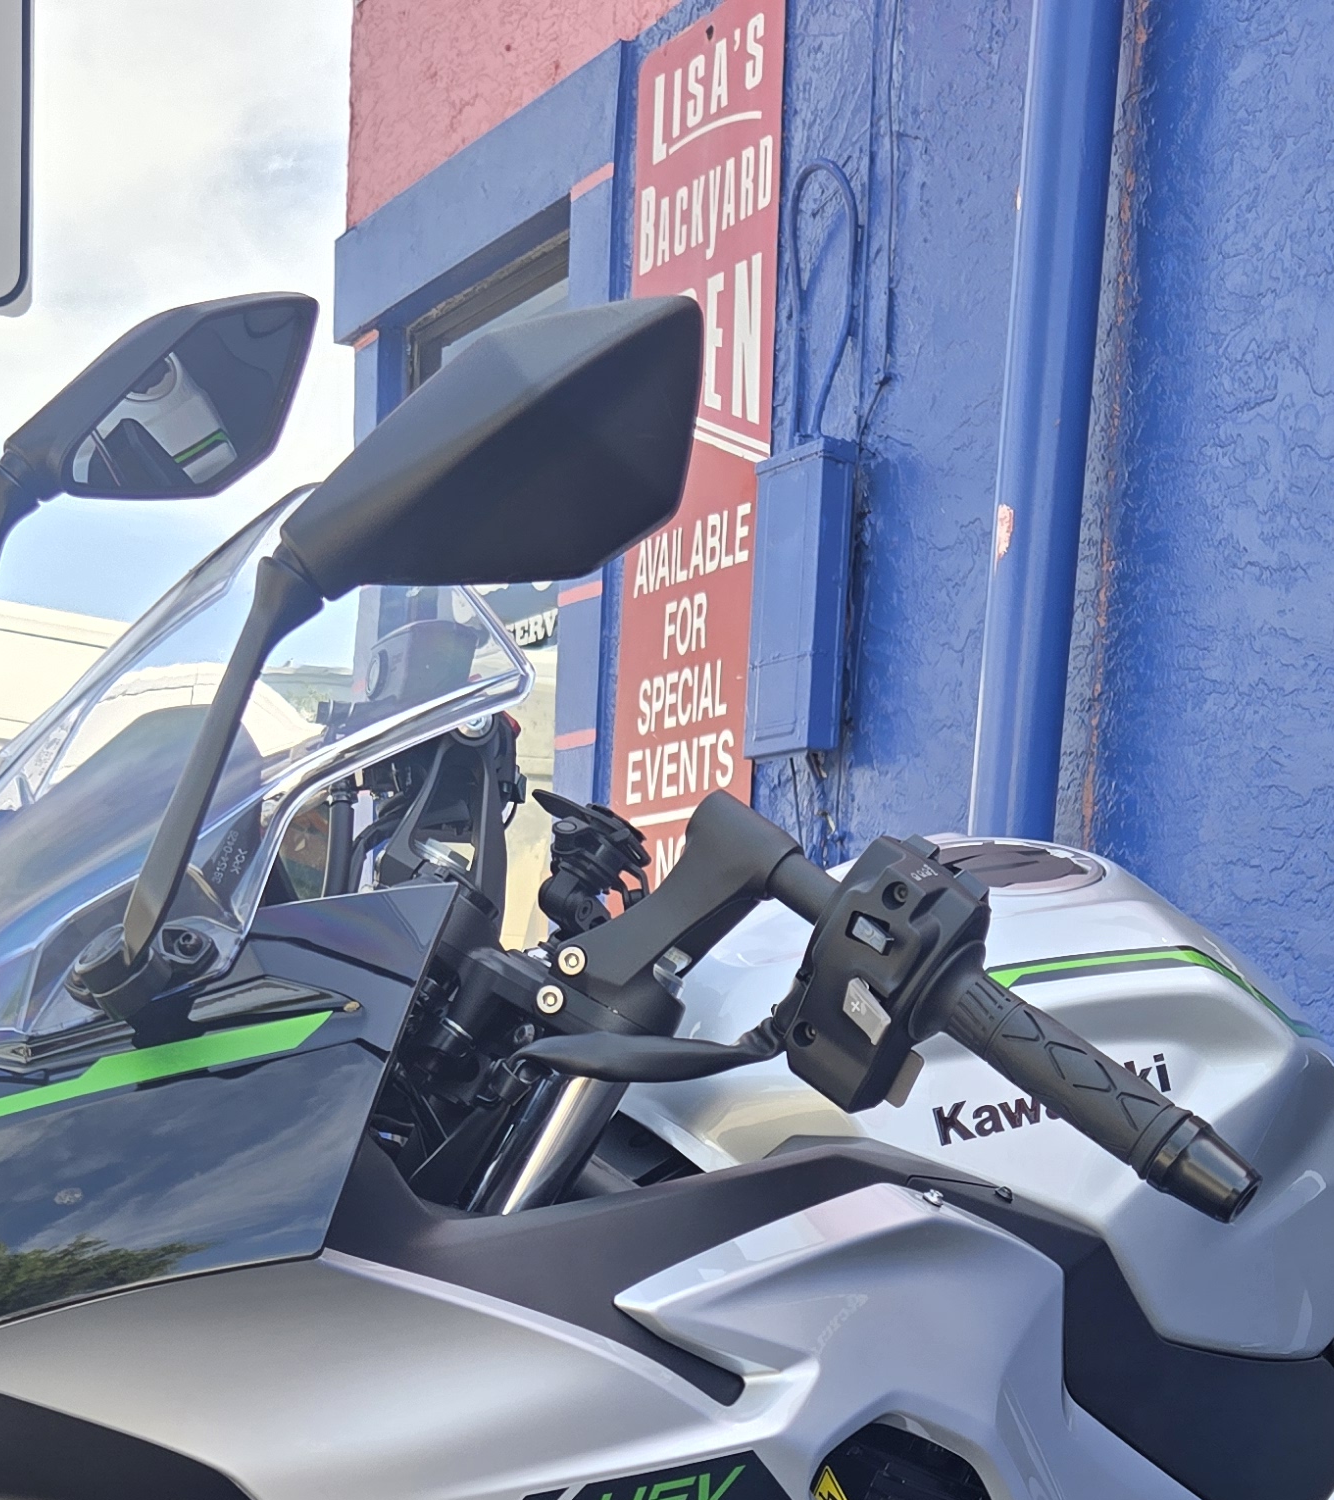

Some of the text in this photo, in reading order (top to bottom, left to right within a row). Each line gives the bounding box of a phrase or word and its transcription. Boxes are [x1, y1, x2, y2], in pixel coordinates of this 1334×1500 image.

[652, 12, 764, 165] LISA'S
[633, 501, 753, 599] AVAILABLE
[663, 596, 708, 660] FOR
[637, 659, 727, 736] SPECIAL
[625, 728, 734, 806] EVENTS
[931, 1052, 1173, 1147] Kawki
